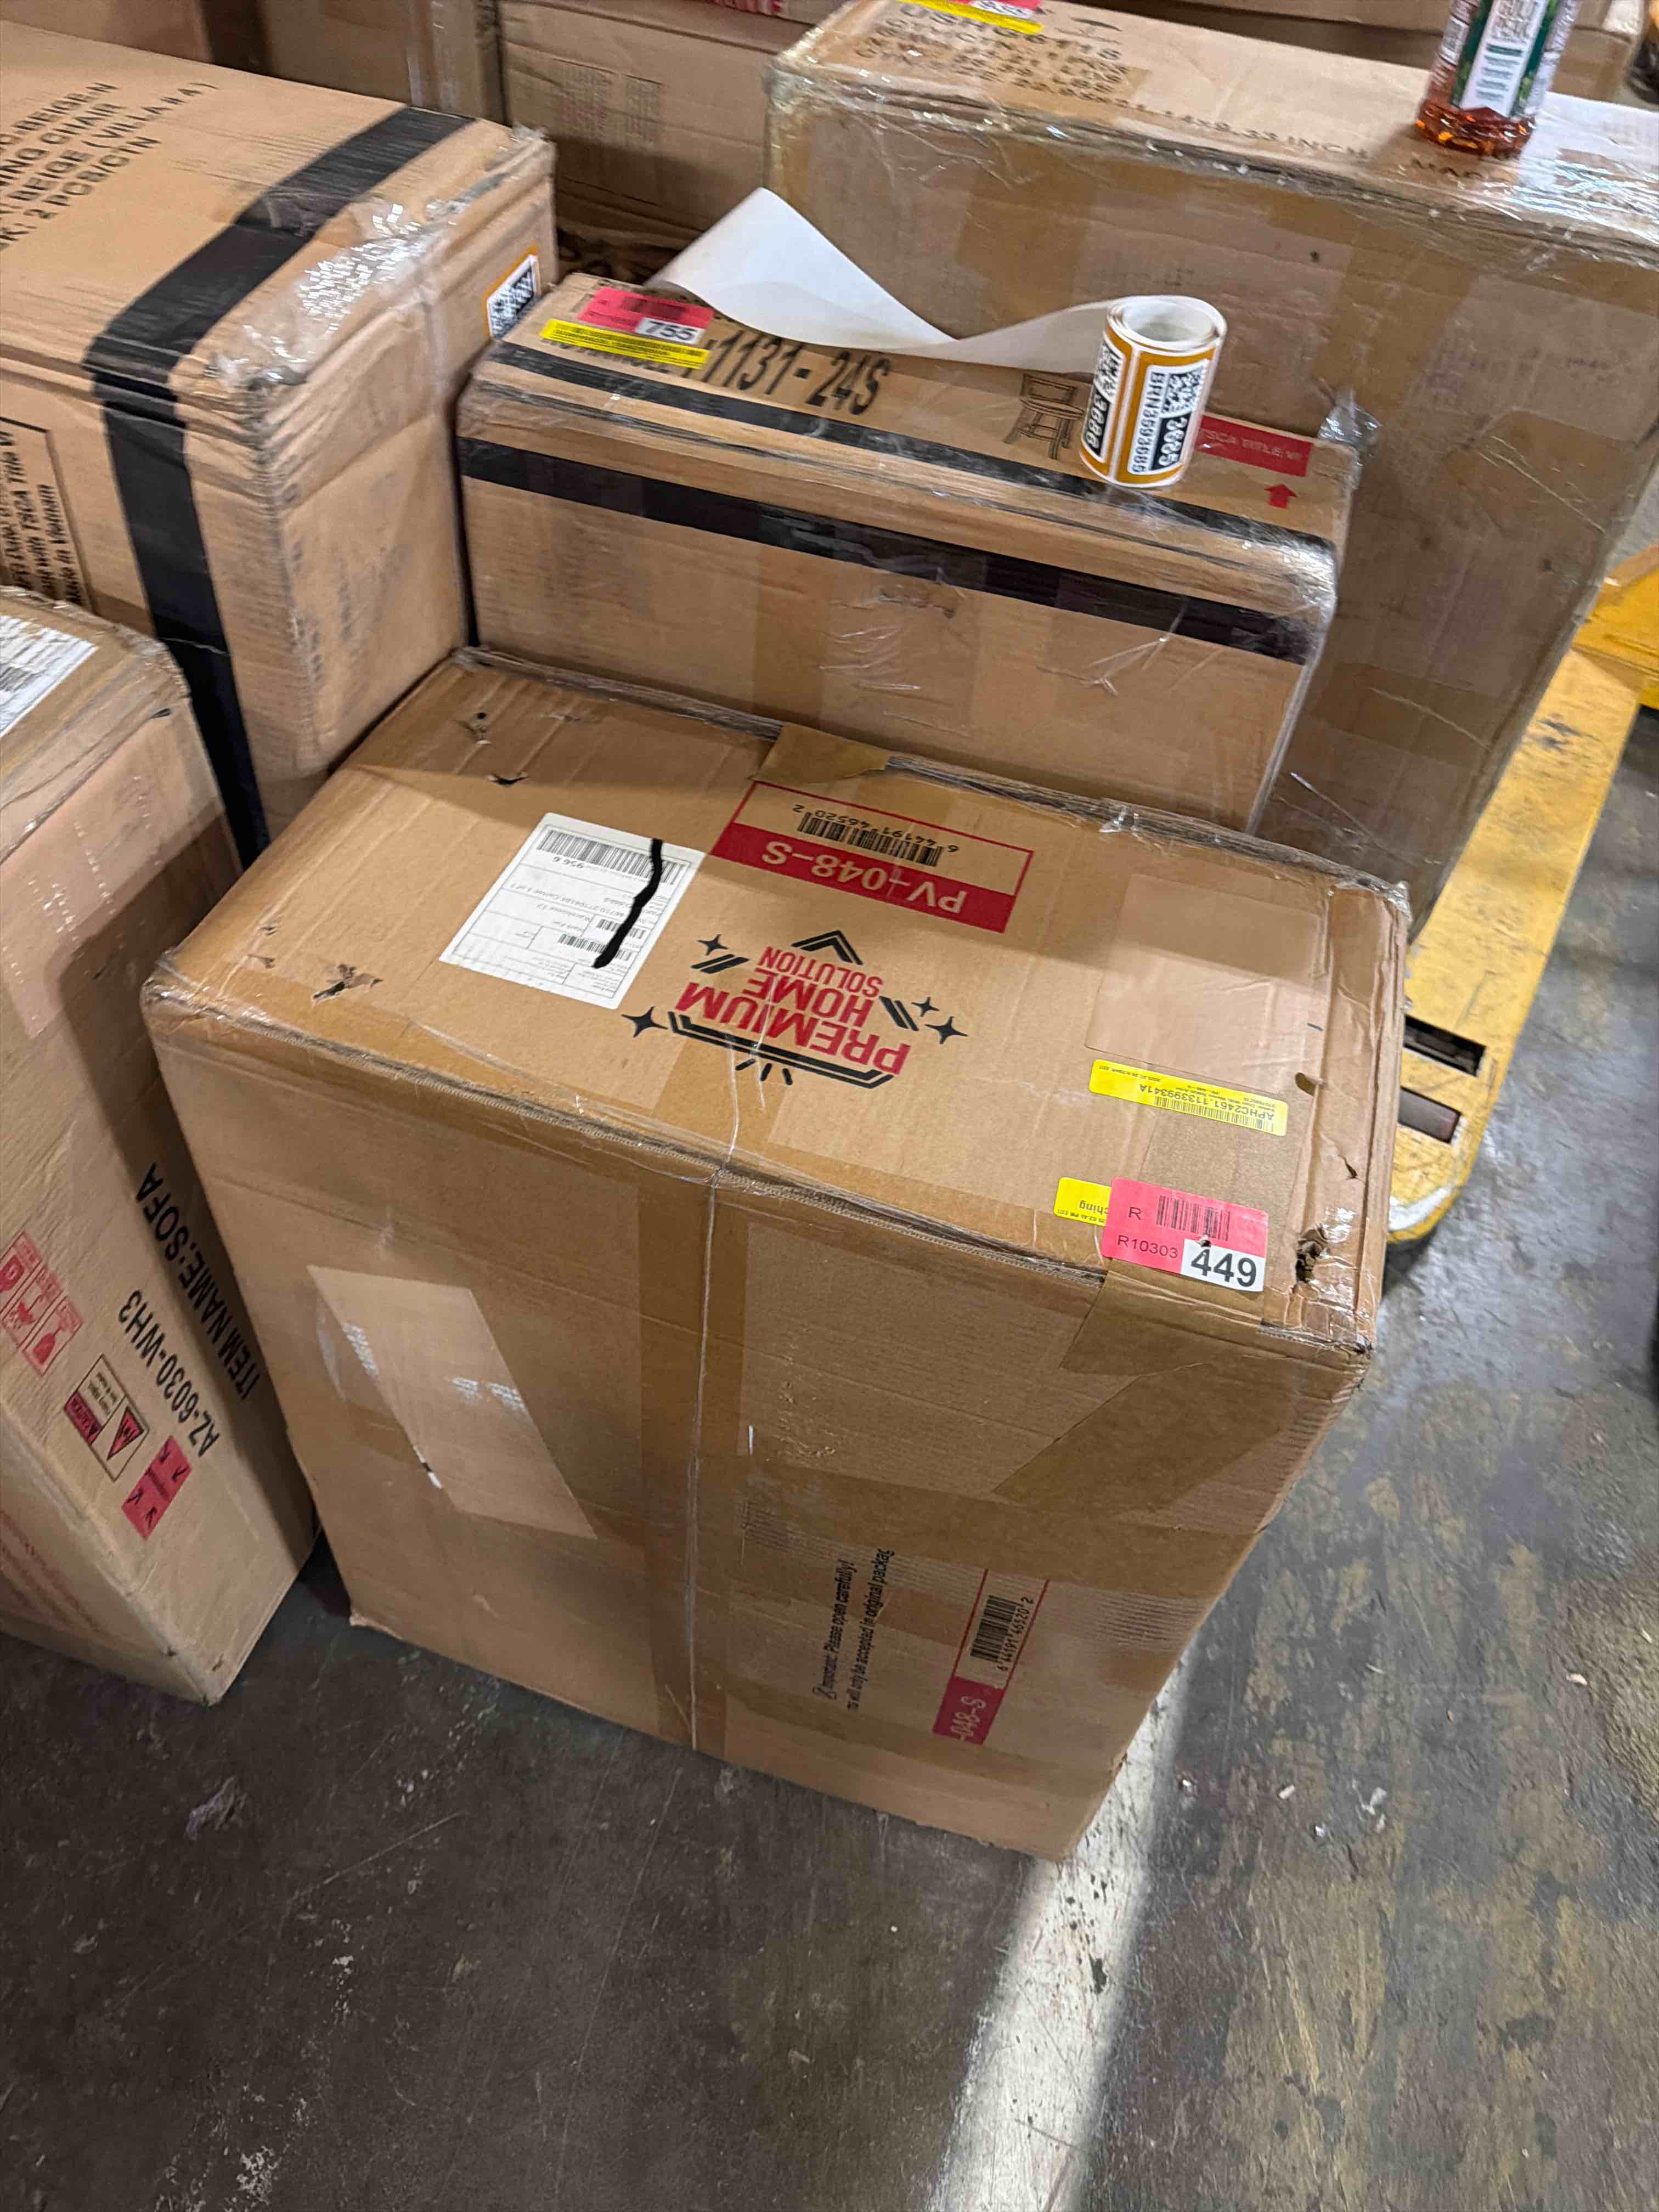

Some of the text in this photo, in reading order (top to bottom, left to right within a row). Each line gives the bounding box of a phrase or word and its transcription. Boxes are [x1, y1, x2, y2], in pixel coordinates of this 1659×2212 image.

[40, 104, 128, 145] CHAIR
[7, 150, 94, 201] BEIGE
[42, 136, 162, 206] PCS/CTN
[646, 320, 696, 341] 755
[792, 804, 960, 853] 6 44191 46520 2
[761, 839, 968, 915] PV-048-S
[757, 946, 882, 998] SOLUTION
[741, 967, 874, 1028] HOME
[675, 982, 911, 1075] PREMIUM
[1127, 1206, 1142, 1221] R
[1117, 1234, 1179, 1259] R10303
[1190, 1249, 1257, 1288] 449
[119, 1290, 221, 1458] AZ-6030-WH3
[217, 1340, 260, 1401] ITEM
[864, 1581, 885, 1618] original
[824, 1624, 843, 1654] Please
